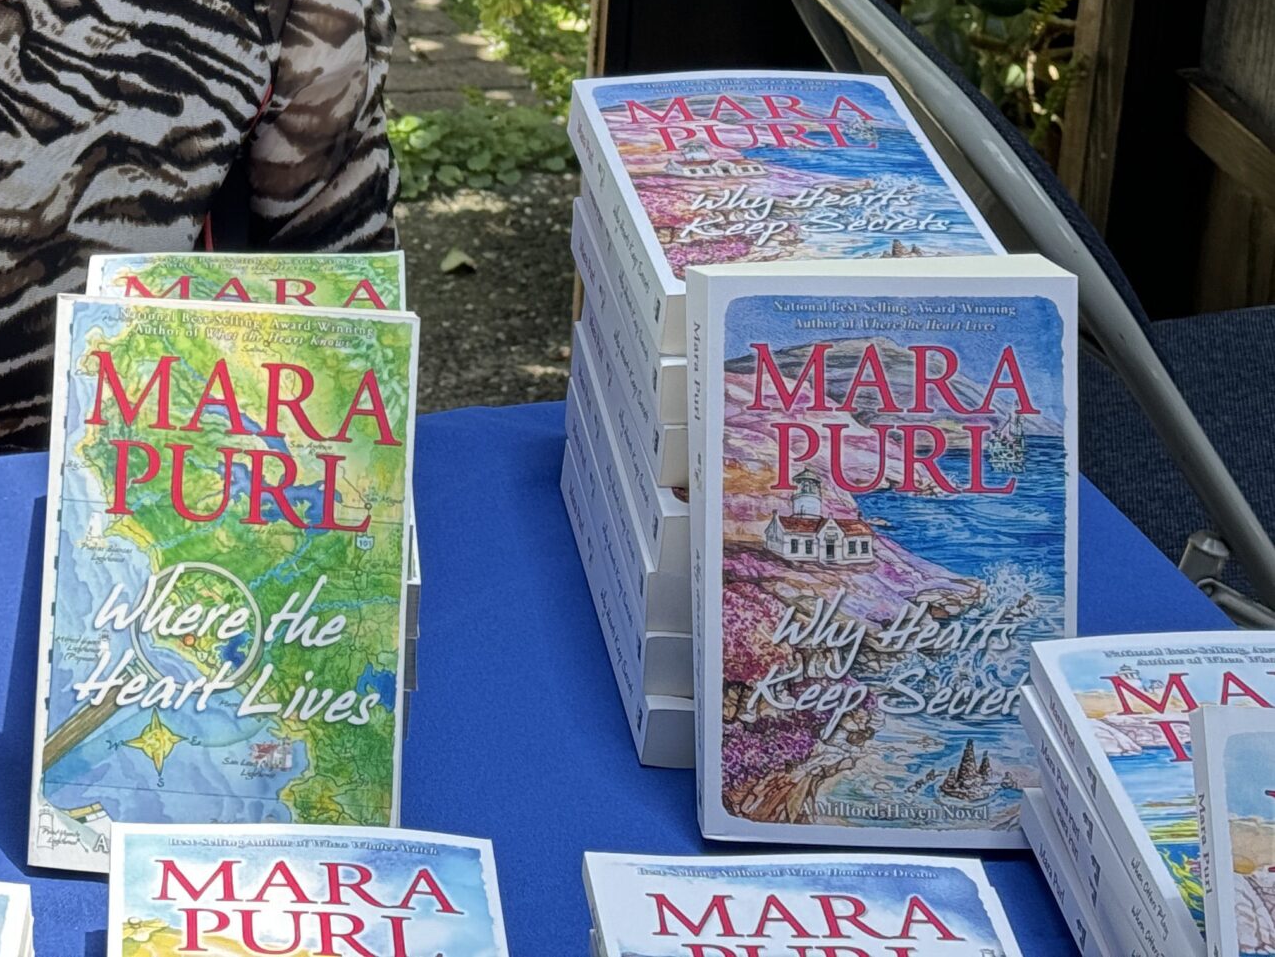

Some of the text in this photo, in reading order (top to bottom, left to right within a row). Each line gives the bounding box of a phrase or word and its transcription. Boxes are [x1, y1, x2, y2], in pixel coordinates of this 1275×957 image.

[620, 94, 875, 126] MARA
[650, 123, 878, 152] PURL
[691, 185, 916, 221] Why Hearts
[679, 212, 951, 246] Keep Secrets
[123, 274, 390, 310] MARA
[774, 300, 827, 312] National
[135, 323, 180, 337] Author
[185, 325, 200, 338] of
[267, 332, 305, 345] Heart
[795, 317, 996, 332] Author of Where the Heart Lives
[693, 321, 702, 422] Mara Purl
[746, 342, 1041, 416] MARA
[84, 350, 403, 447] MARA
[770, 422, 1017, 495] PURL
[105, 439, 372, 532] PURL
[93, 563, 347, 648] Where the
[772, 587, 1019, 680] Why Hearts
[72, 648, 236, 712] Heart
[236, 663, 381, 726] Lives
[746, 663, 868, 740] Keep
[1100, 670, 1275, 716] MA
[942, 805, 989, 821] Novel
[93, 833, 110, 854] A
[1198, 793, 1214, 894] Mara Purl
[152, 858, 465, 915] MARA
[1131, 857, 1144, 886] When
[178, 907, 445, 957] PURL
[645, 892, 967, 942] MARA
